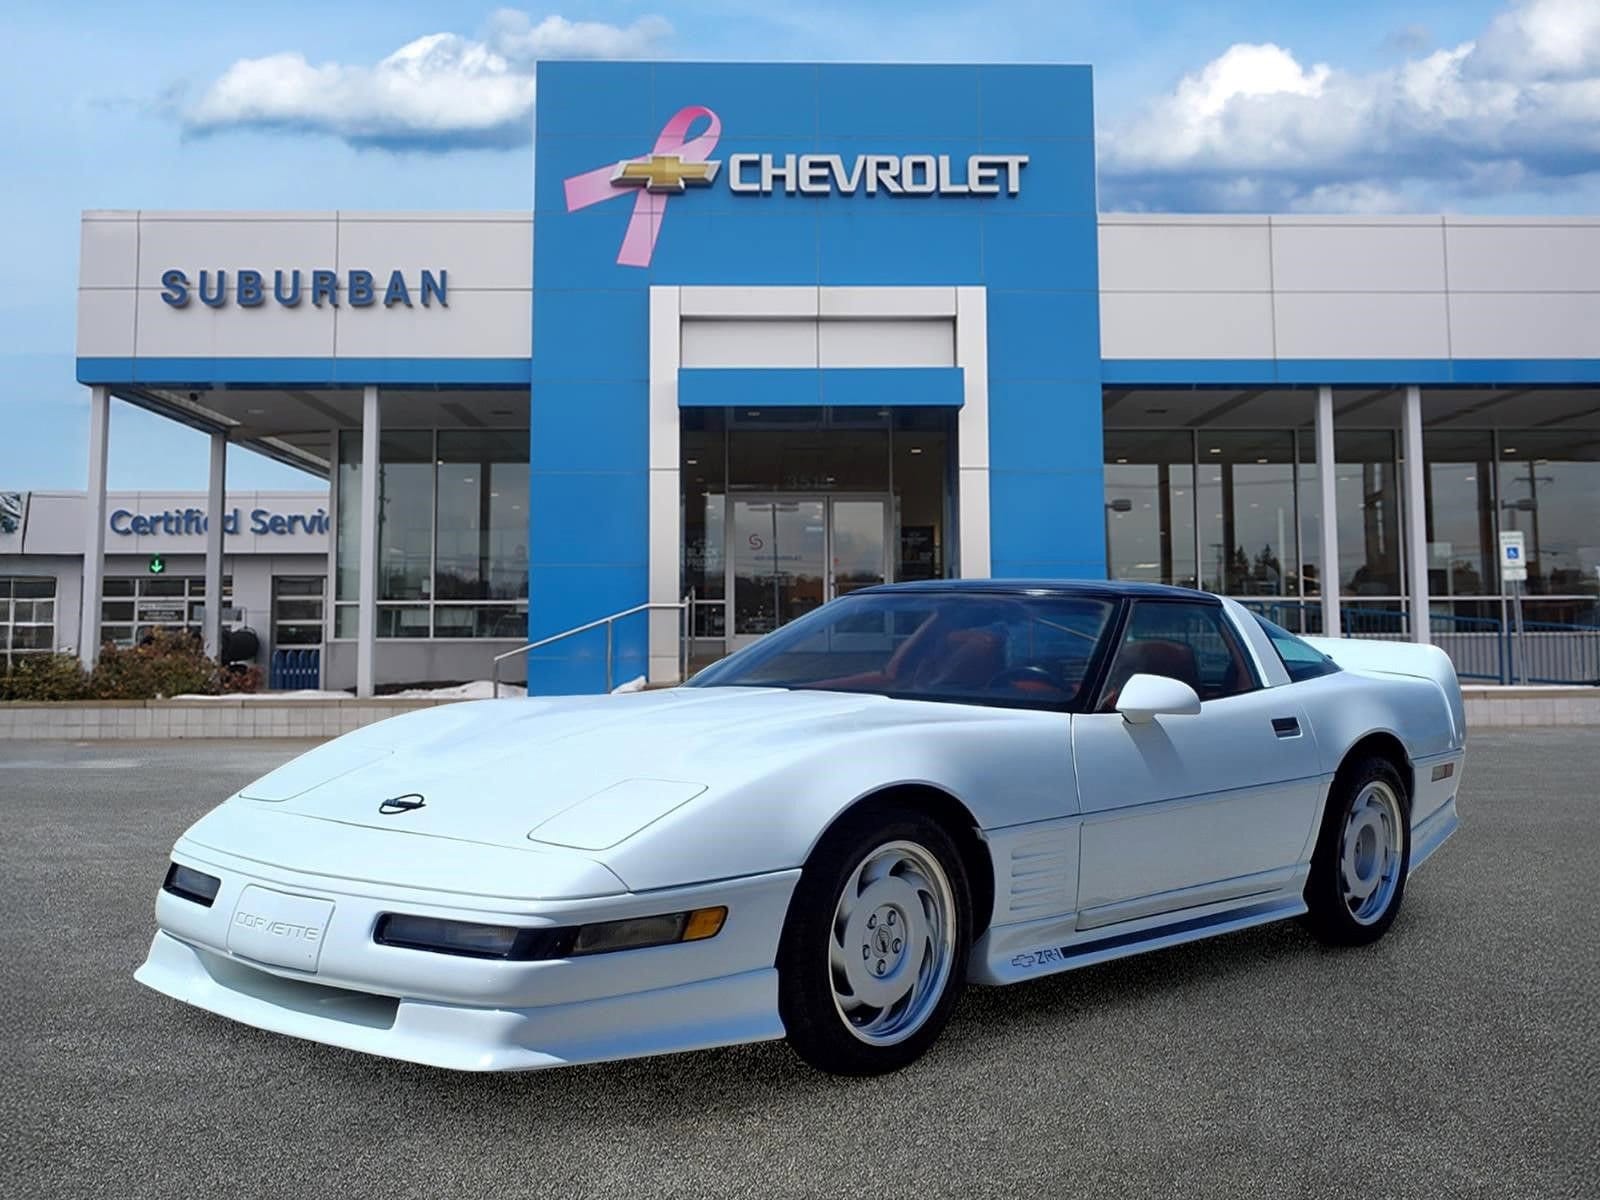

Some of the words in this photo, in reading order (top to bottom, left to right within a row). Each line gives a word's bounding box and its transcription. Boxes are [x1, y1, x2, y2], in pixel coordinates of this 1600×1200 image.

[728, 153, 1030, 194] CHEVROLET
[160, 269, 450, 309] SUBURBAN
[235, 911, 320, 941] CORVETTE
